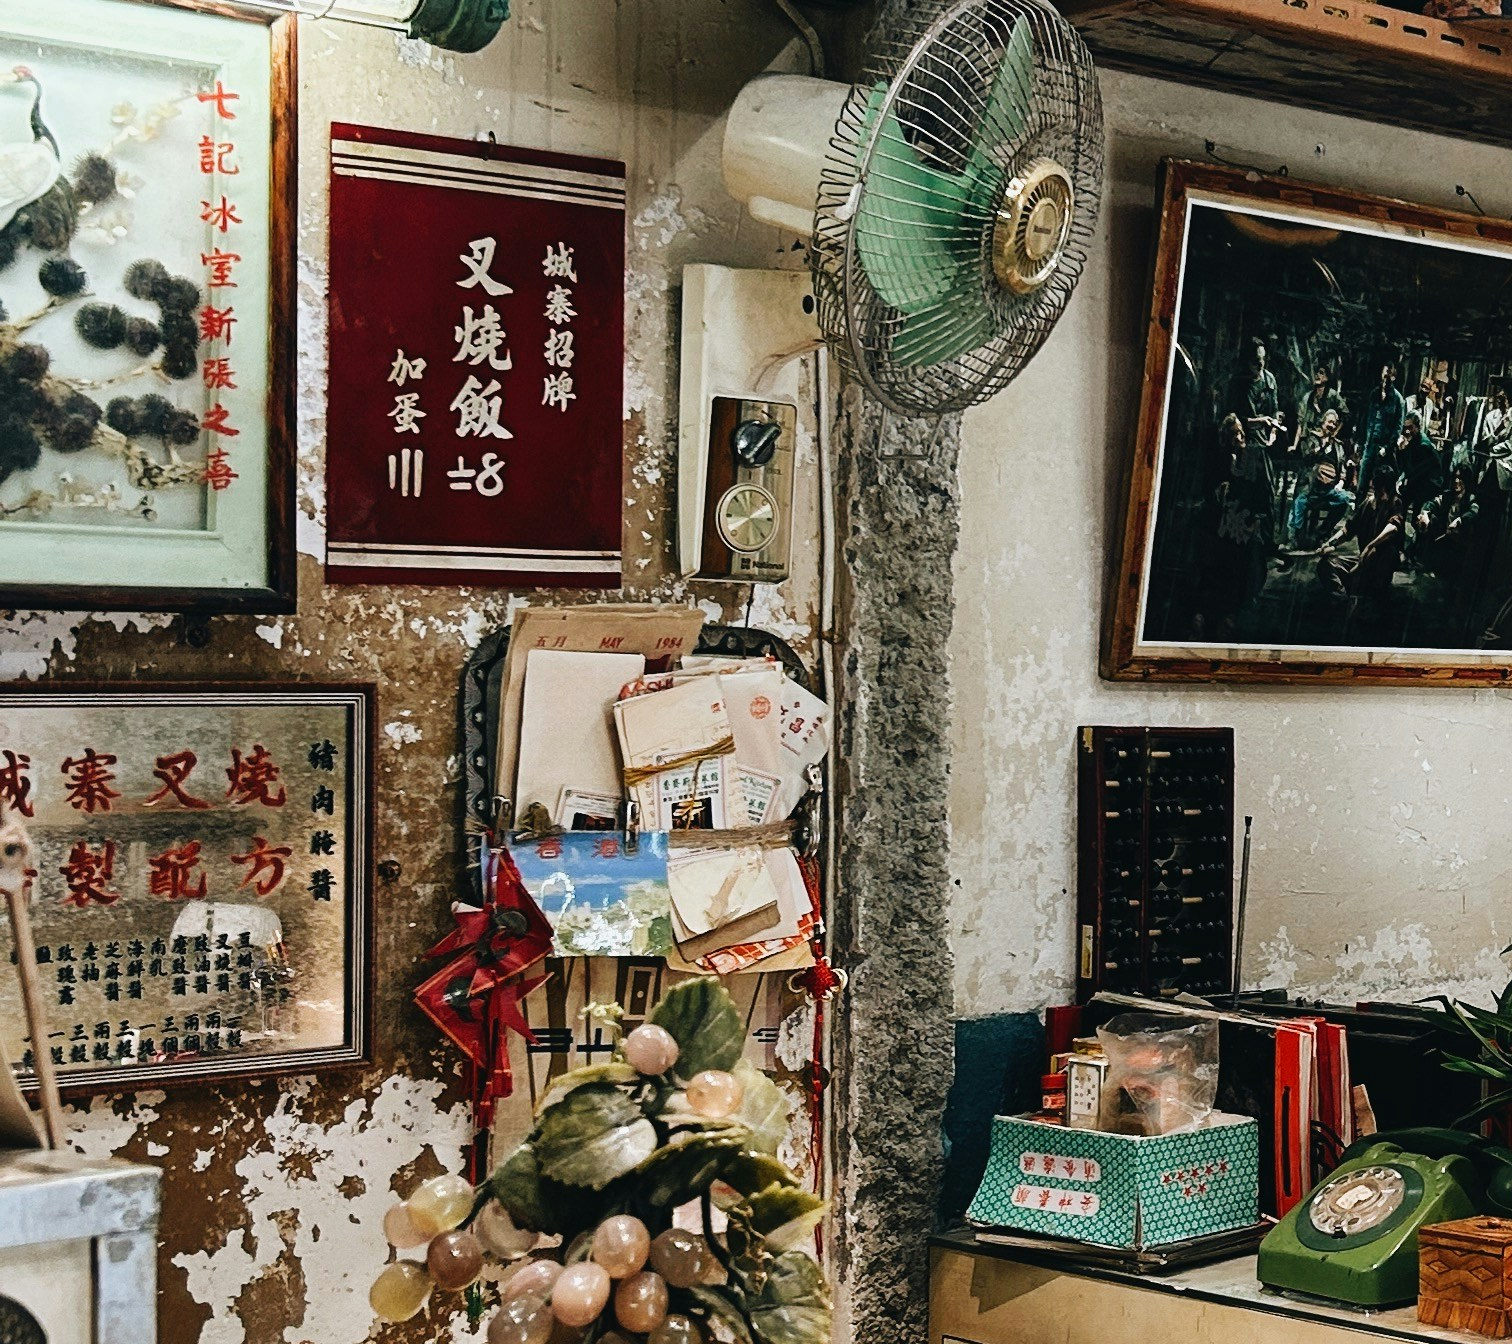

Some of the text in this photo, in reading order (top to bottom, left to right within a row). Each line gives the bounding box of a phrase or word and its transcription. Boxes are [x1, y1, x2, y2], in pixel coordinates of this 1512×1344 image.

[197, 80, 241, 491] 七記冰室新張之喜
[540, 242, 578, 413] 城寨招牌
[752, 560, 785, 570] National
[536, 636, 567, 648] 五月
[599, 636, 683, 649] MAY 1984
